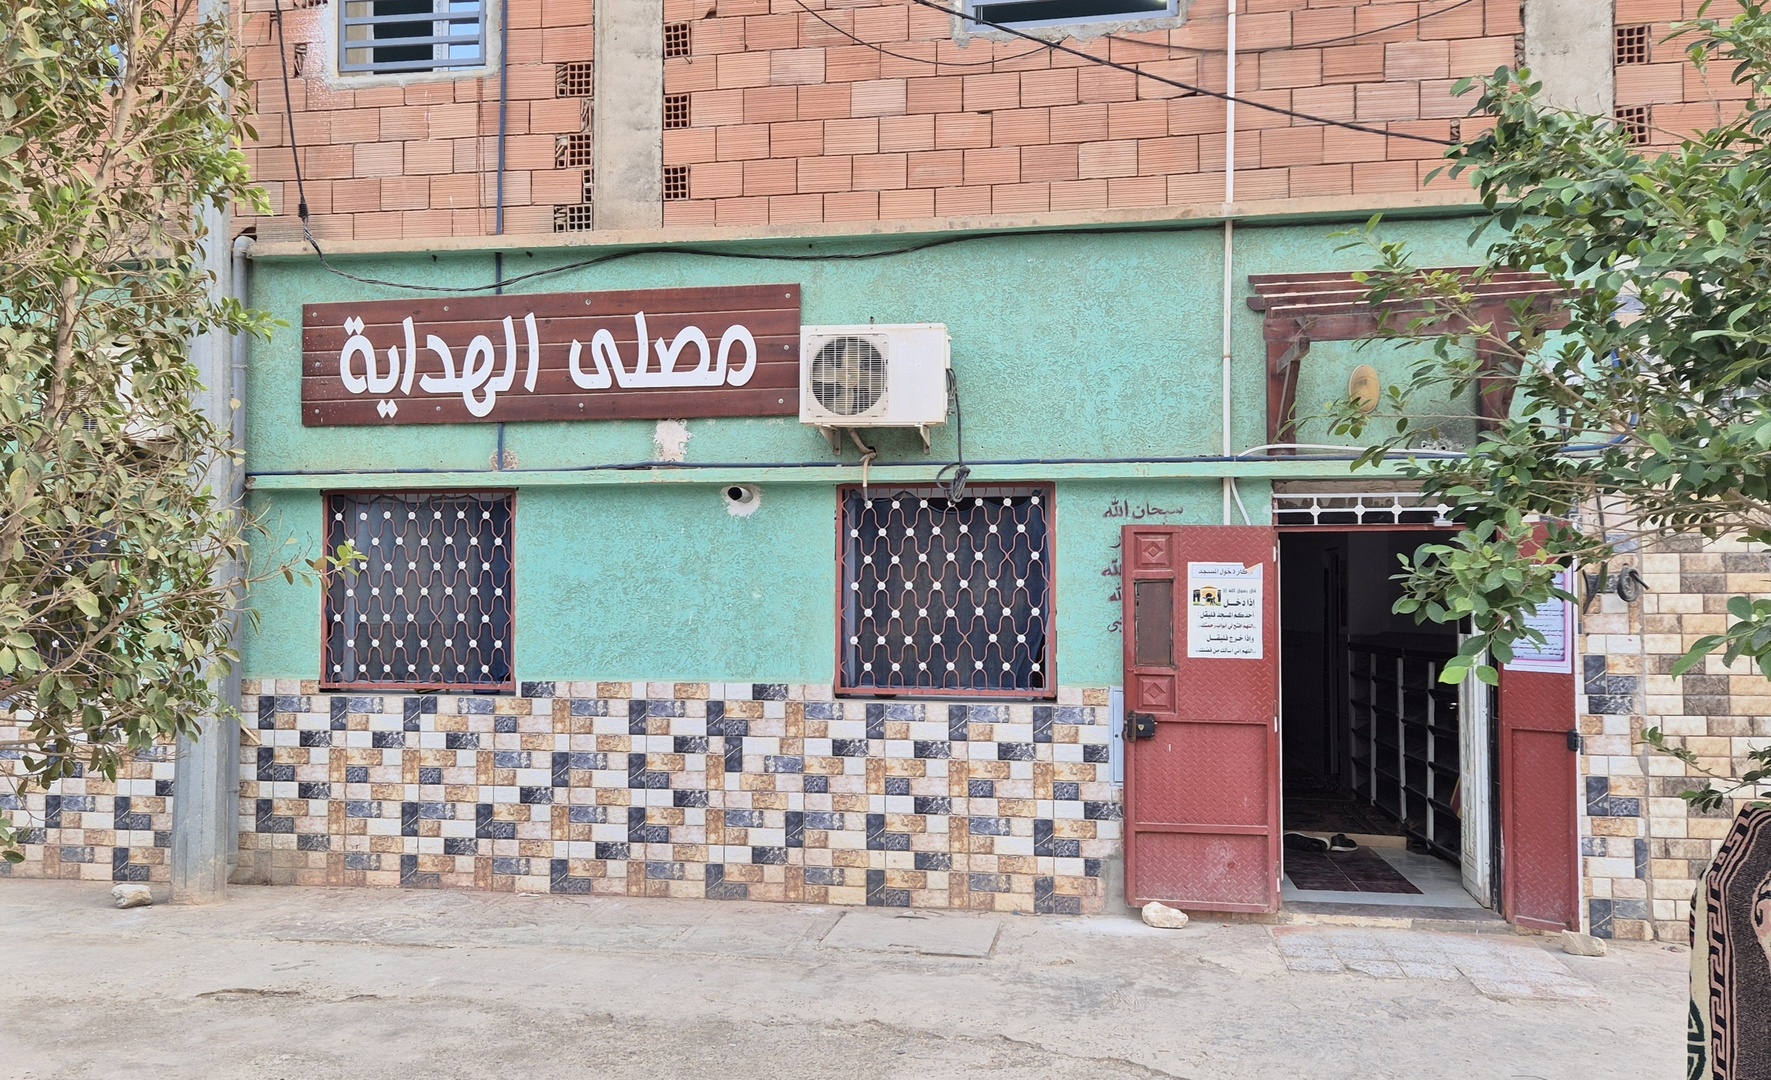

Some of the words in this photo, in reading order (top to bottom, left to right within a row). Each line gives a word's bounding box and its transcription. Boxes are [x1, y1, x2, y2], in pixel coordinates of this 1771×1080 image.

[569, 311, 757, 389] مصلى
[340, 311, 539, 417] الهداية
[1103, 497, 1129, 518] الله
[1132, 502, 1184, 519] سبحان
[1198, 568, 1219, 576] المسجد
[1220, 567, 1236, 577] دخول
[1223, 597, 1246, 608] دخل
[1217, 611, 1233, 620] المسجد
[1229, 634, 1244, 643] خرج
